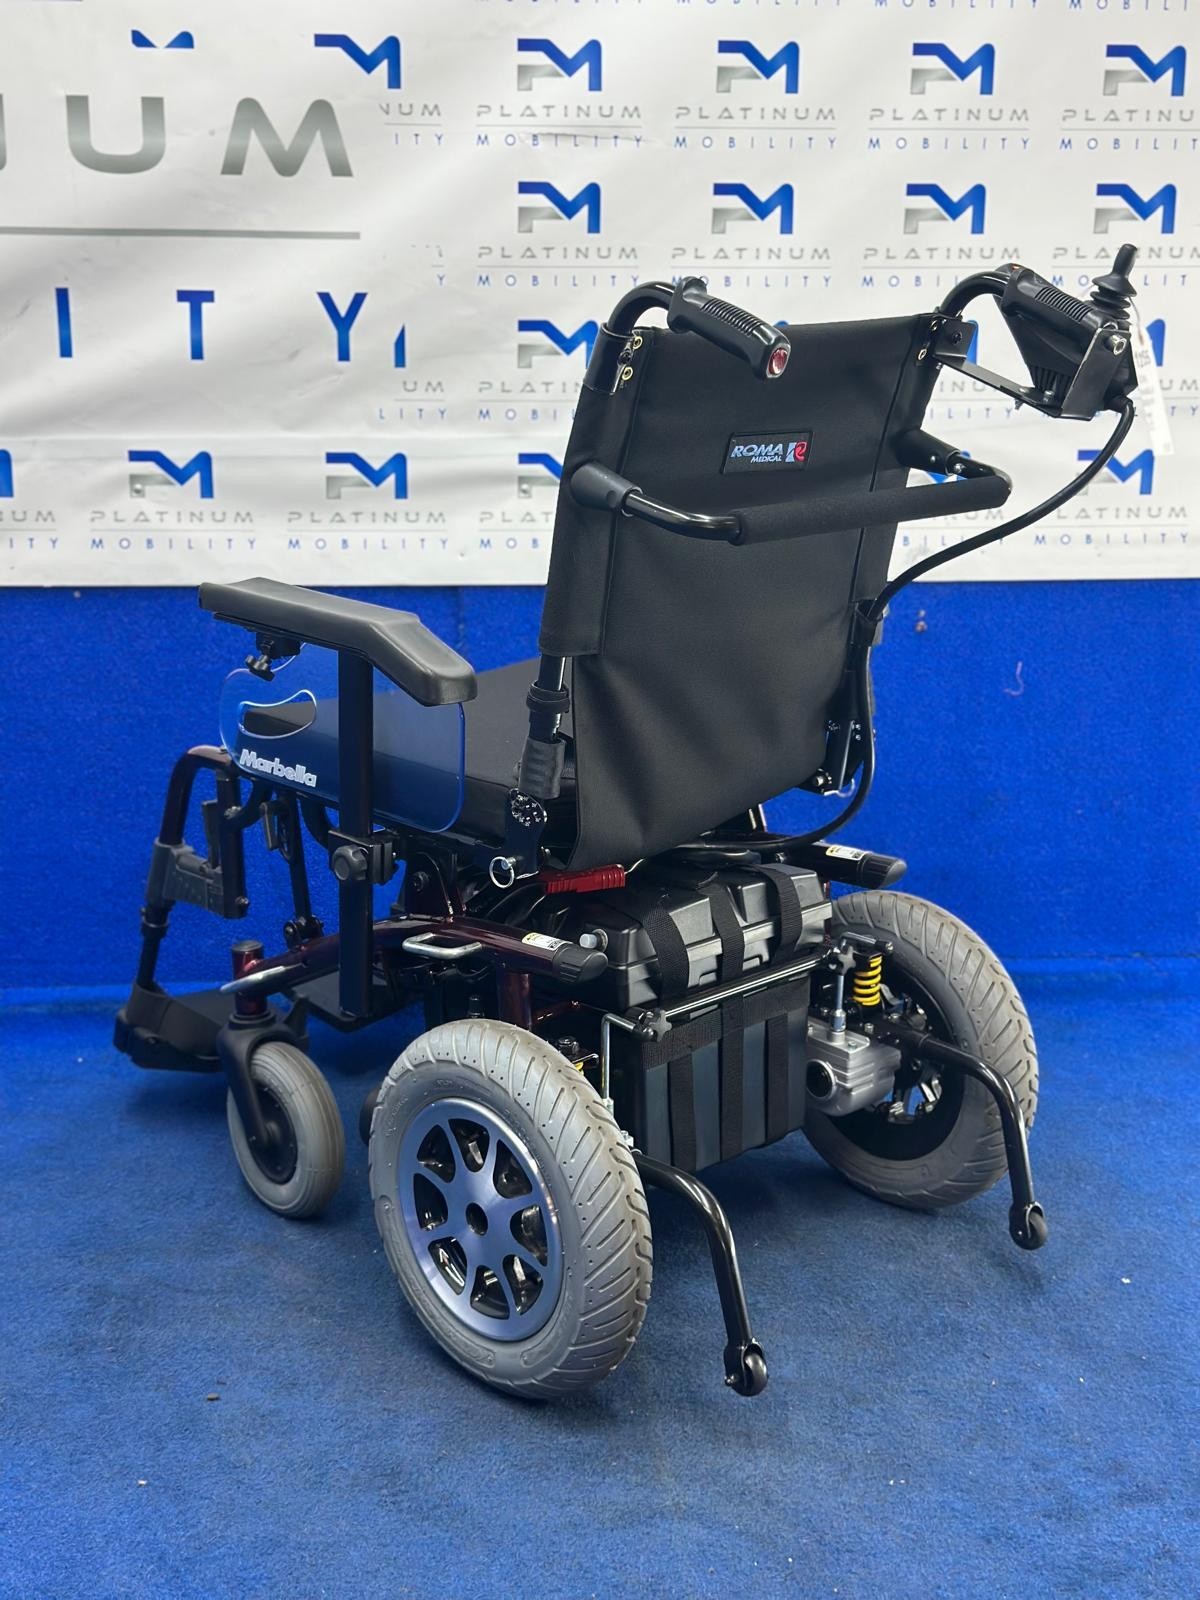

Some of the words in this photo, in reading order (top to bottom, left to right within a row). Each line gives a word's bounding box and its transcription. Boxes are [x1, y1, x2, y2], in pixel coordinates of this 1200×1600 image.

[476, 104, 642, 119] PLATINUM
[675, 106, 836, 121] PLATINUM
[868, 108, 1030, 122] PLATINUM
[0, 93, 354, 177] UM
[476, 133, 643, 148] MOBILITY
[674, 136, 836, 149] MOBILITY
[867, 137, 1030, 150] MOBILITY
[477, 246, 638, 259] PLATINUM
[671, 247, 831, 260] PLATINUM
[863, 247, 1021, 260] PLATINUM
[477, 274, 640, 287] MOBILITY
[1051, 274, 1188, 287] MOLIT
[54, 286, 369, 363] ITY
[730, 444, 784, 458] ROMA
[750, 455, 783, 464] MEDICAL
[0, 510, 56, 522] UM
[90, 511, 254, 523] PLATINUM
[287, 511, 446, 523] PLATINUM
[90, 537, 257, 550] MOBILITY
[288, 538, 448, 550] MOBILITY
[1034, 533, 1189, 545] MOBILITY
[239, 748, 318, 788] Marbella
